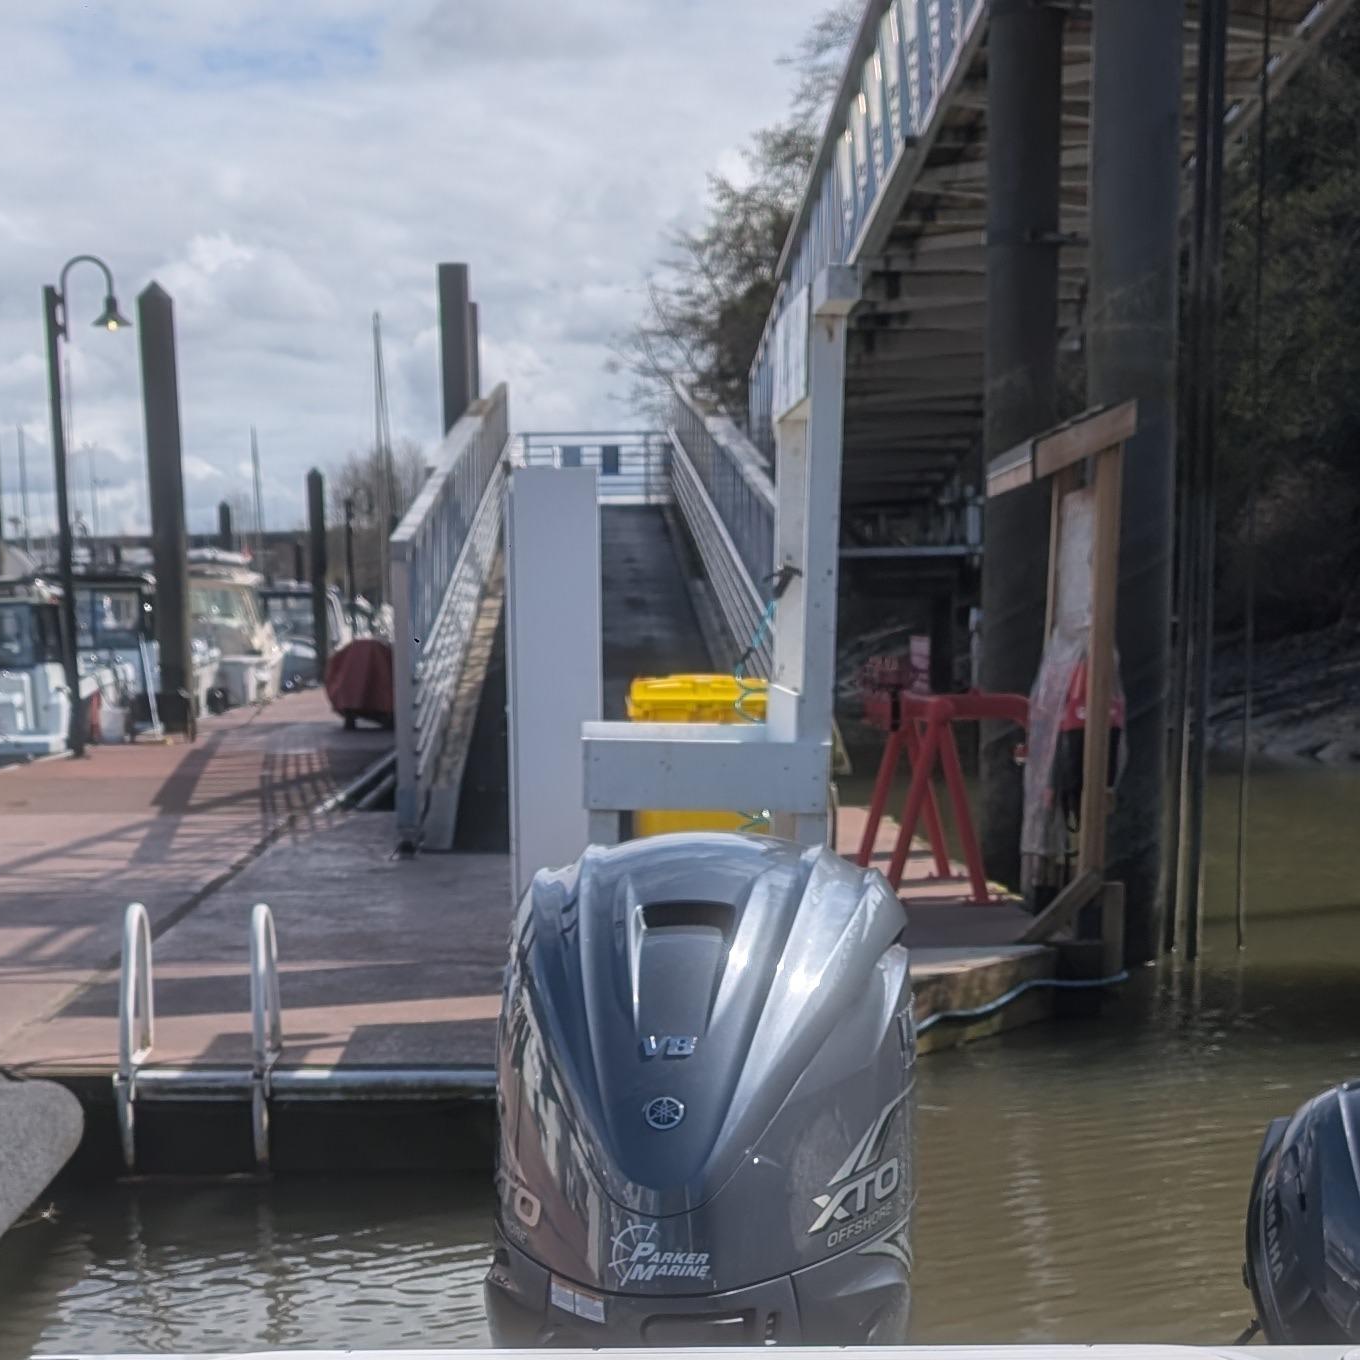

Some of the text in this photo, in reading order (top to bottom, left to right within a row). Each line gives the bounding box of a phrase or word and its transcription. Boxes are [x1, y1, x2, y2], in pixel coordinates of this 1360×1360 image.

[642, 1035, 698, 1056] V8
[807, 1157, 899, 1233] XTO
[827, 1201, 893, 1248] OFFSHORE
[629, 1263, 711, 1281] MARINE
